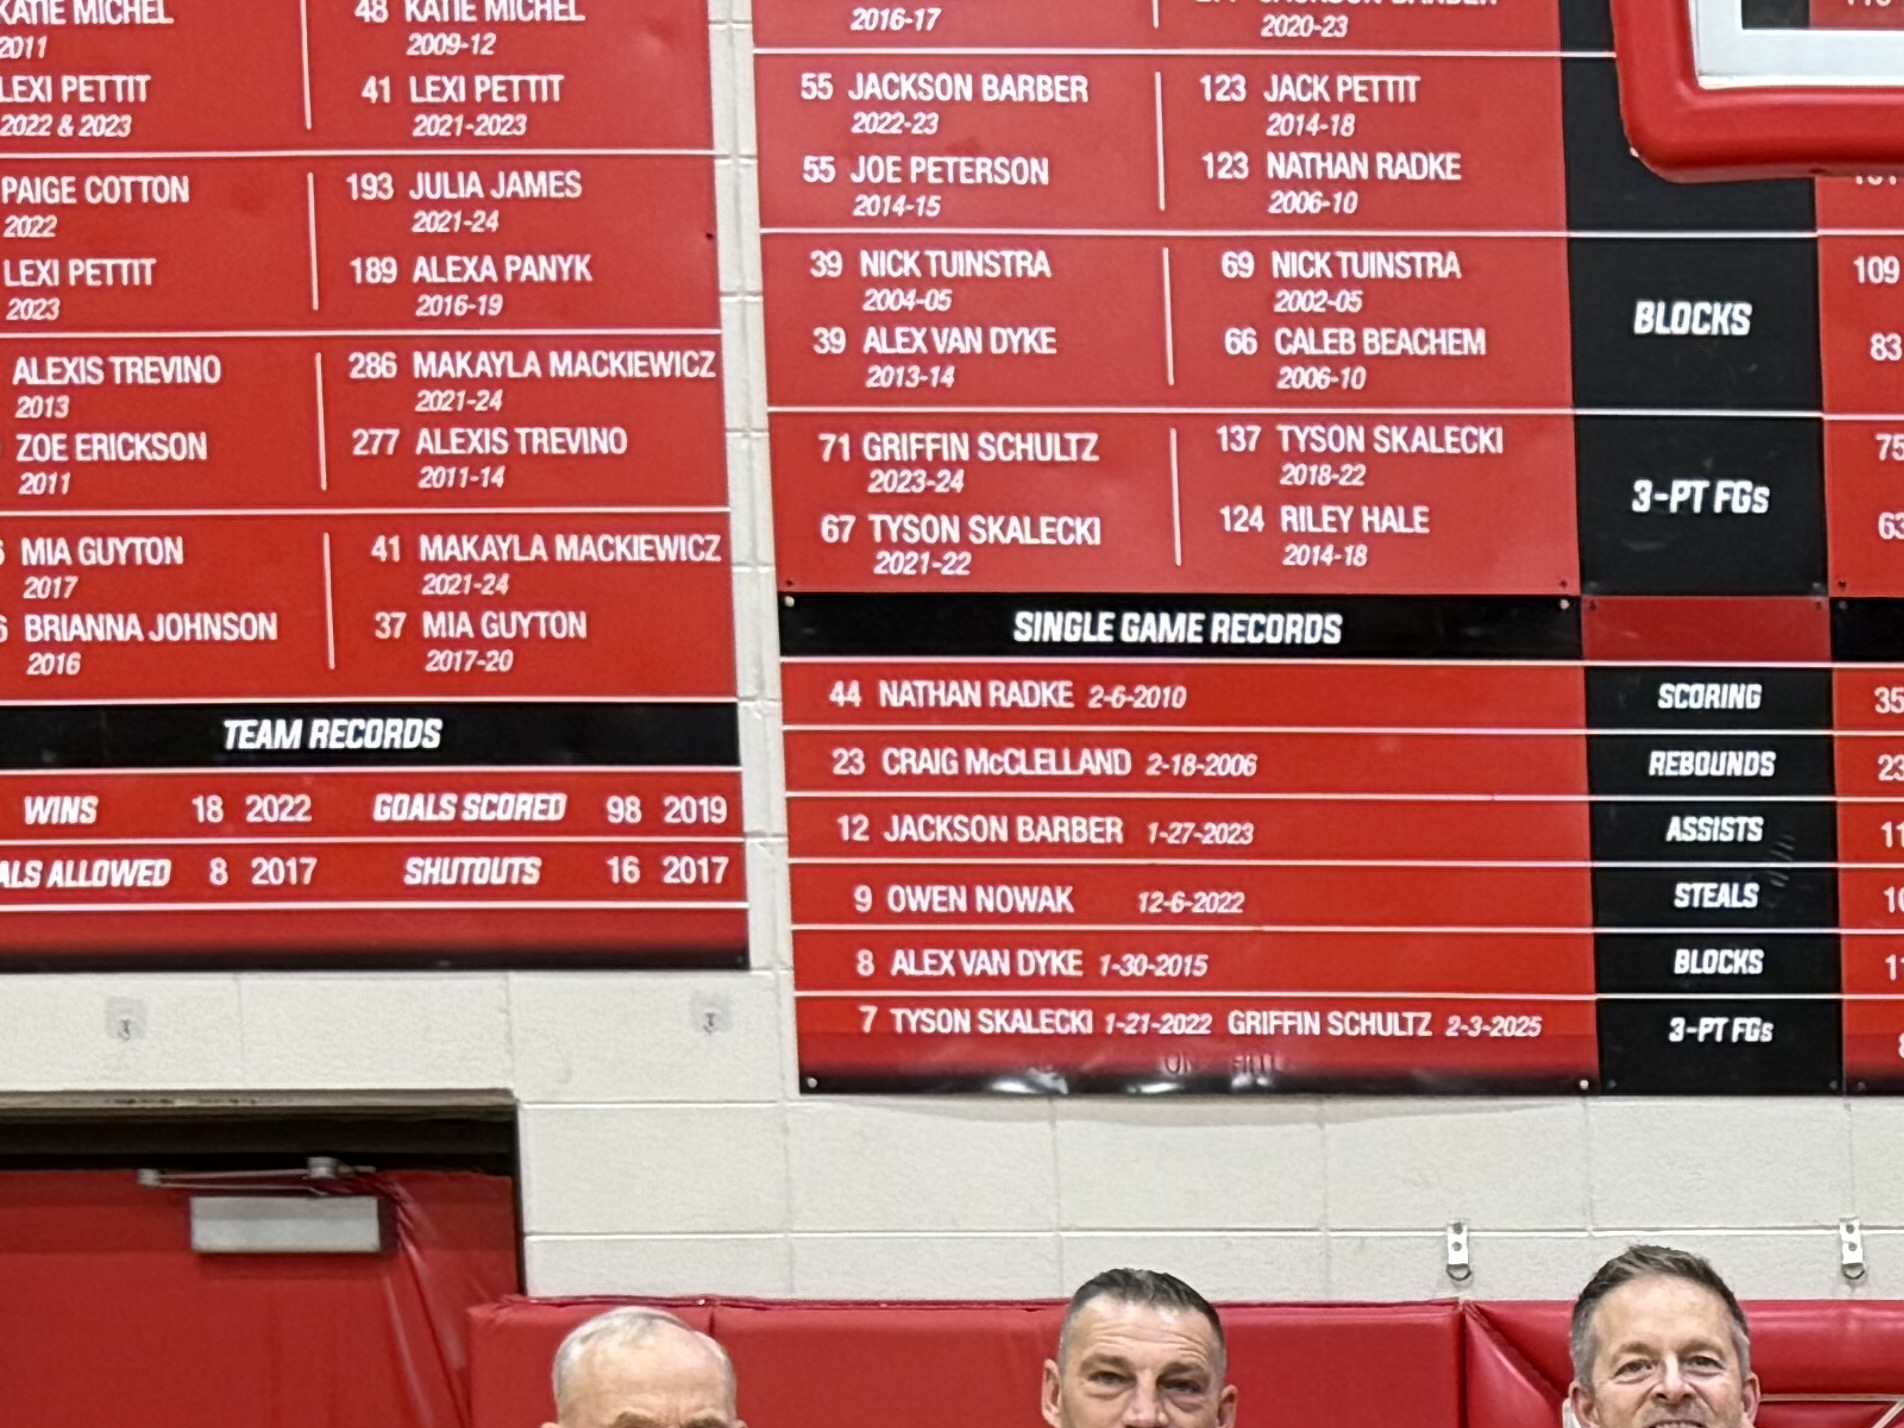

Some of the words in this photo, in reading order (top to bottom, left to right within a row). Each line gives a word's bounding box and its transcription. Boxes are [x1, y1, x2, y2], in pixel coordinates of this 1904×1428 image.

[801, 73, 833, 99] 55
[849, 73, 972, 101] JACKSON
[982, 74, 1088, 102] BARBER
[852, 112, 938, 134] 2022-23
[1203, 152, 1248, 179] 123
[1268, 152, 1368, 179] NATHAN
[1376, 152, 1461, 180] RADKE
[2, 176, 76, 204] PAIGE
[85, 176, 189, 203] COTTON
[1268, 190, 1357, 213] 2006-10
[4, 215, 57, 237] 2022
[1634, 301, 1752, 335] BLOCKS
[1632, 480, 1710, 513] 3-PT
[1714, 480, 1769, 513] FGs
[371, 535, 399, 561] 41
[420, 535, 548, 561] MAKAYLA
[556, 534, 721, 561] MACKIEWICZ
[422, 573, 508, 595] 2021-24
[1014, 611, 1115, 642] SINGLE
[1121, 613, 1205, 643] GAME
[1211, 613, 1342, 643] RECORDS
[830, 681, 861, 706] 44
[880, 680, 981, 707] NATHAN
[989, 681, 1074, 707] RADKE
[1089, 685, 1186, 708] 2-6-2010
[1658, 683, 1762, 709] SCORING
[224, 719, 302, 749] TEAM
[309, 718, 442, 748] RECORDS
[1649, 751, 1776, 776] REBOUNDS
[25, 796, 98, 824] WINS
[193, 795, 223, 822] 18
[246, 795, 311, 822] 2022
[373, 793, 457, 821] GOALS
[462, 793, 567, 820] SCORED
[607, 796, 641, 823] 98
[664, 796, 727, 823] 2019
[1666, 817, 1763, 841] ASSISTS
[47, 859, 171, 887] ALLOWED
[210, 858, 228, 885] 8
[252, 857, 316, 884] 2017
[404, 857, 541, 884] SHUTOUTS
[607, 856, 640, 883] 16
[663, 856, 728, 883] 2017
[1675, 883, 1759, 907] STEALS
